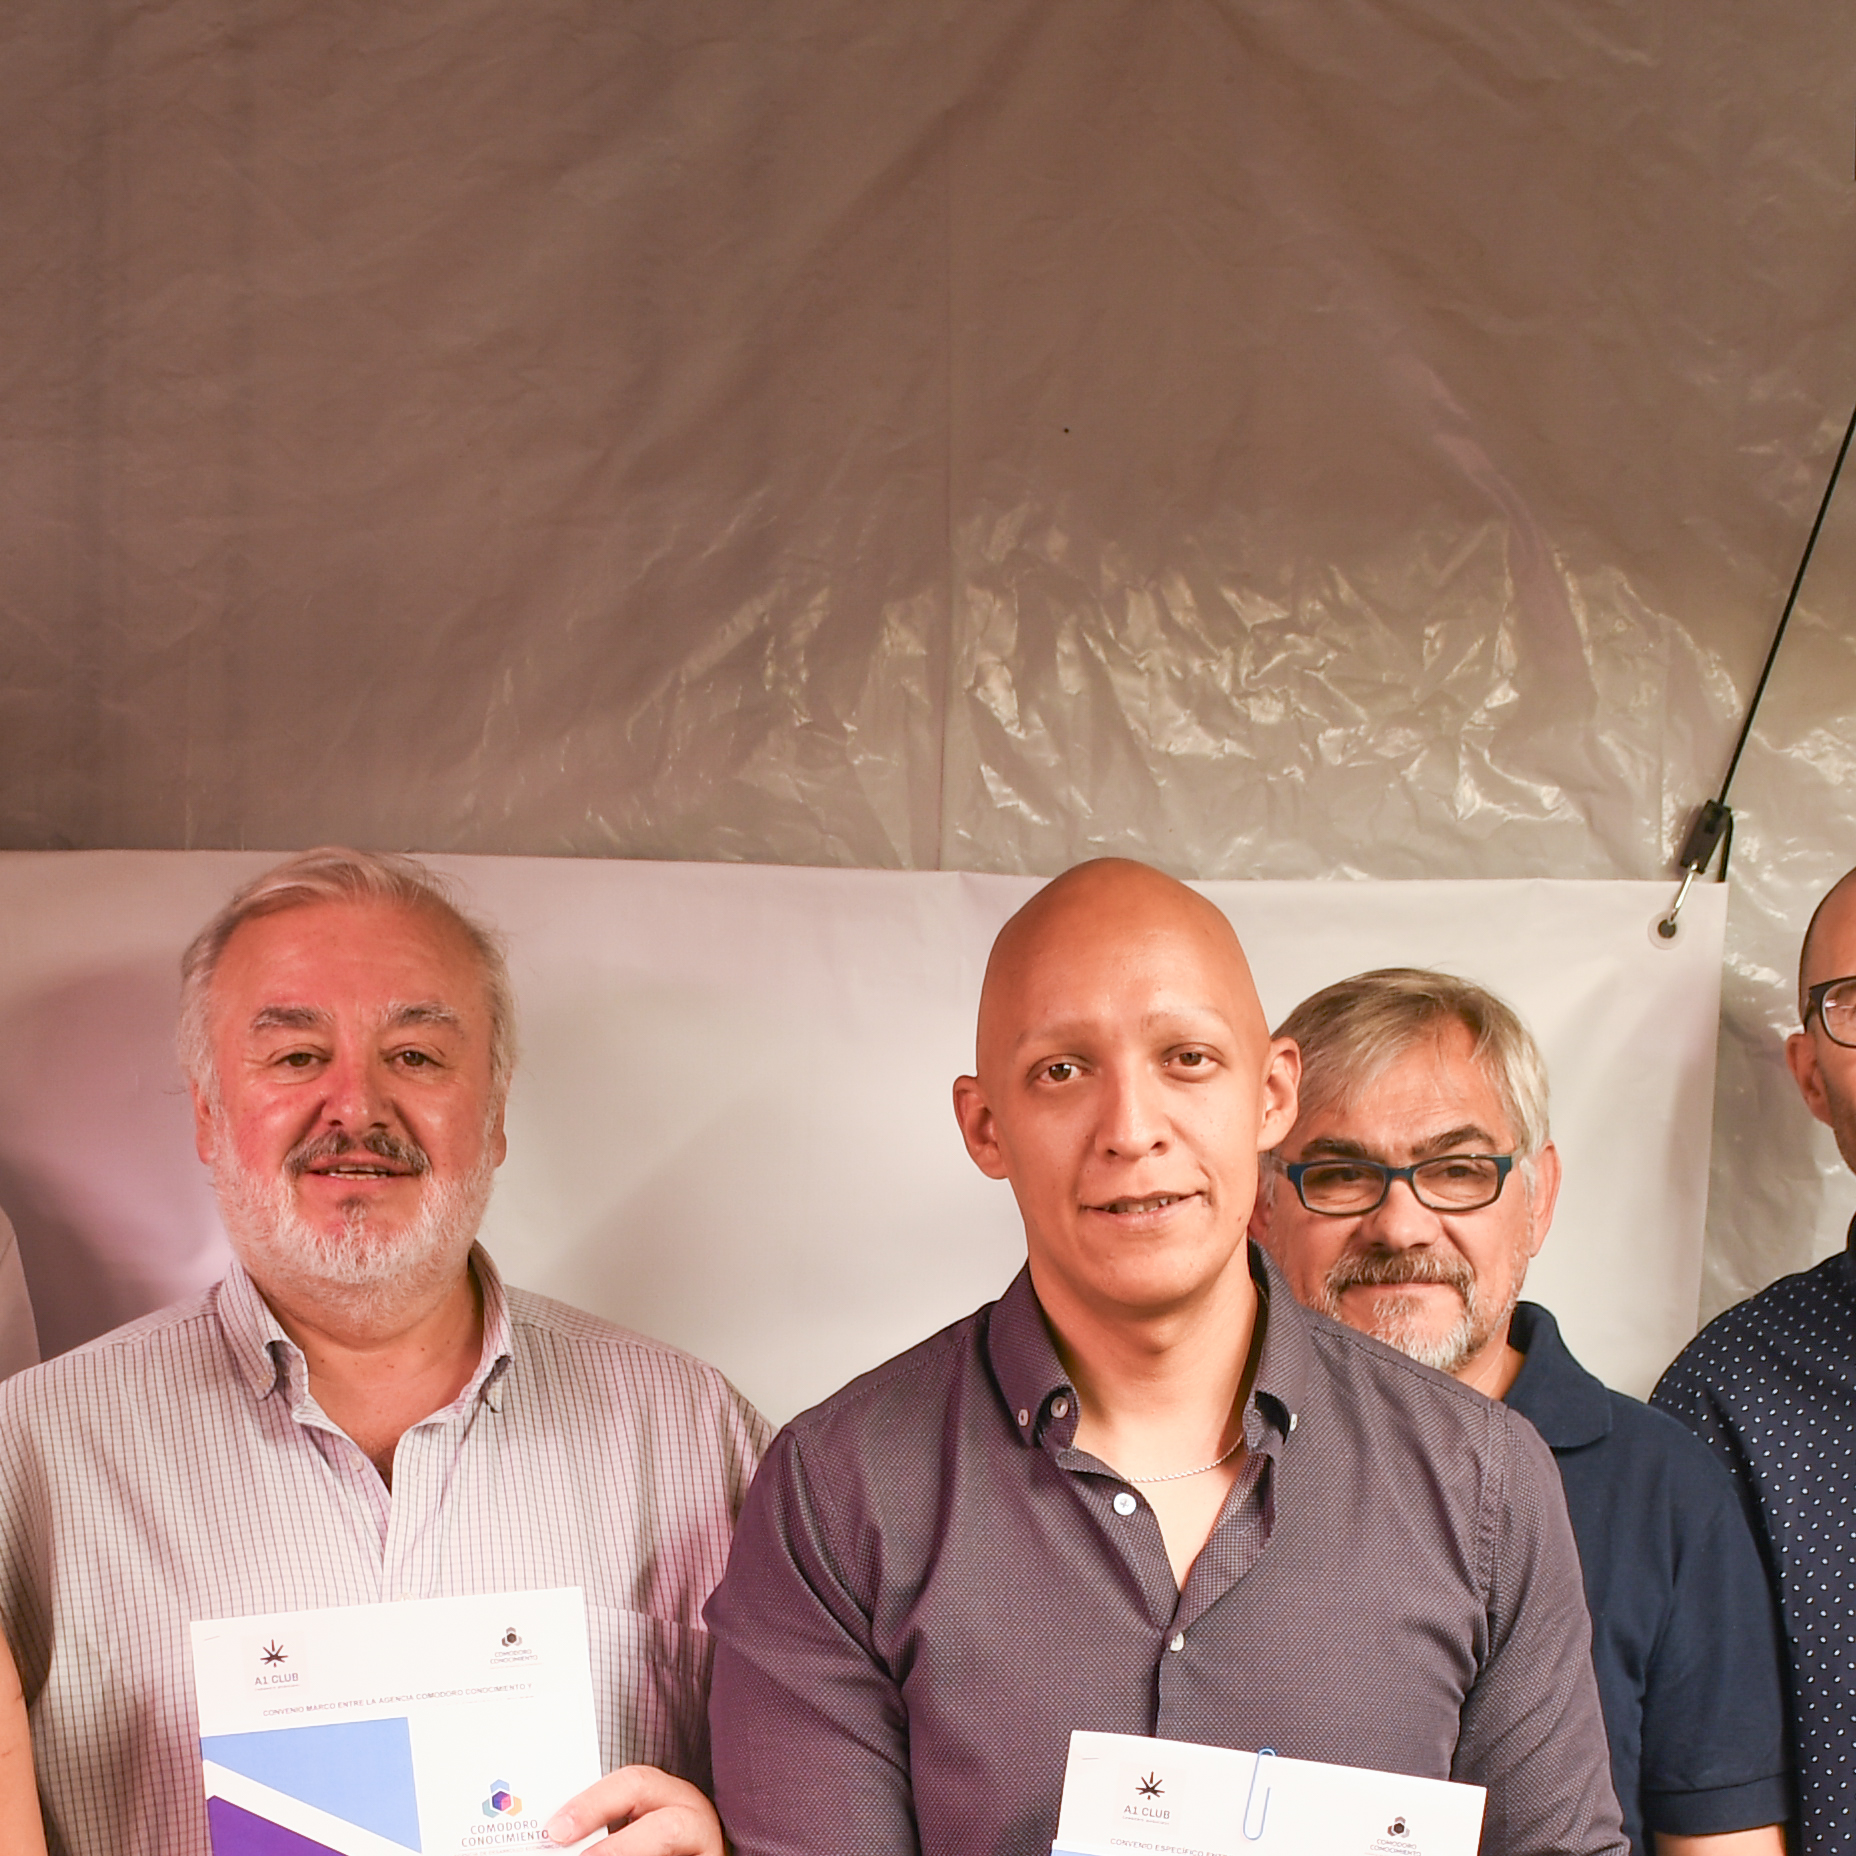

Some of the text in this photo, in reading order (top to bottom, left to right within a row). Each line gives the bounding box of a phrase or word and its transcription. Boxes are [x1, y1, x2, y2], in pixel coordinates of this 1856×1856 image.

[254, 1672, 299, 1686] A1 CLUB
[263, 1706, 304, 1717] CONVENIO
[306, 1703, 336, 1712] MARCO
[338, 1699, 364, 1709] ENTRE
[379, 1694, 414, 1704] AGENCIA
[416, 1689, 463, 1700] COMODORO
[465, 1683, 526, 1695] CONOCIMIENTO
[1124, 1804, 1170, 1819] A1 CLUB
[470, 1819, 538, 1835] COMODORO
[461, 1829, 549, 1848] CONOCIMIENTO
[1110, 1838, 1153, 1850] CONVENIO
